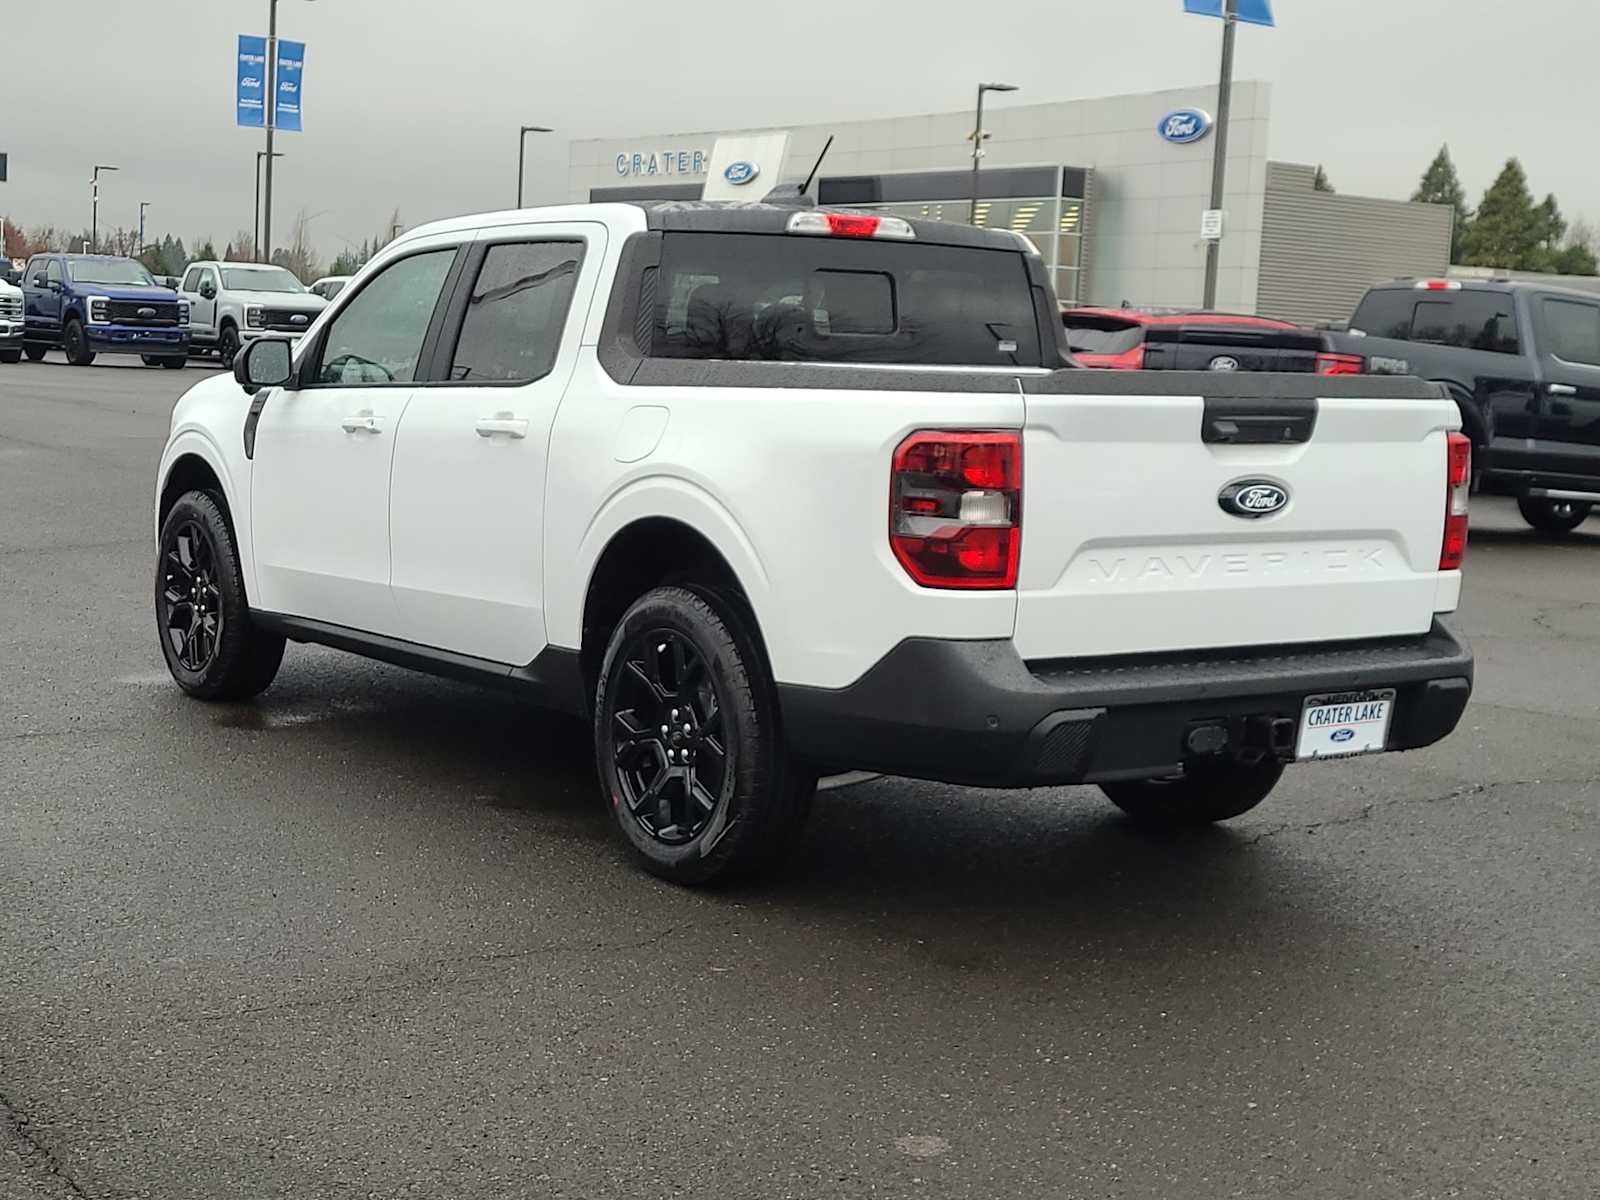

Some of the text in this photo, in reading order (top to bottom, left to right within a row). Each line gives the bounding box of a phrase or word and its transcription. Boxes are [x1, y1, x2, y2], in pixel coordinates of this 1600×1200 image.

[1165, 115, 1196, 136] Ford
[616, 151, 707, 176] CRATER
[1246, 488, 1279, 509] Ford
[1087, 547, 1385, 582] MAVERICK
[1308, 702, 1384, 726] CRATER LAKE
